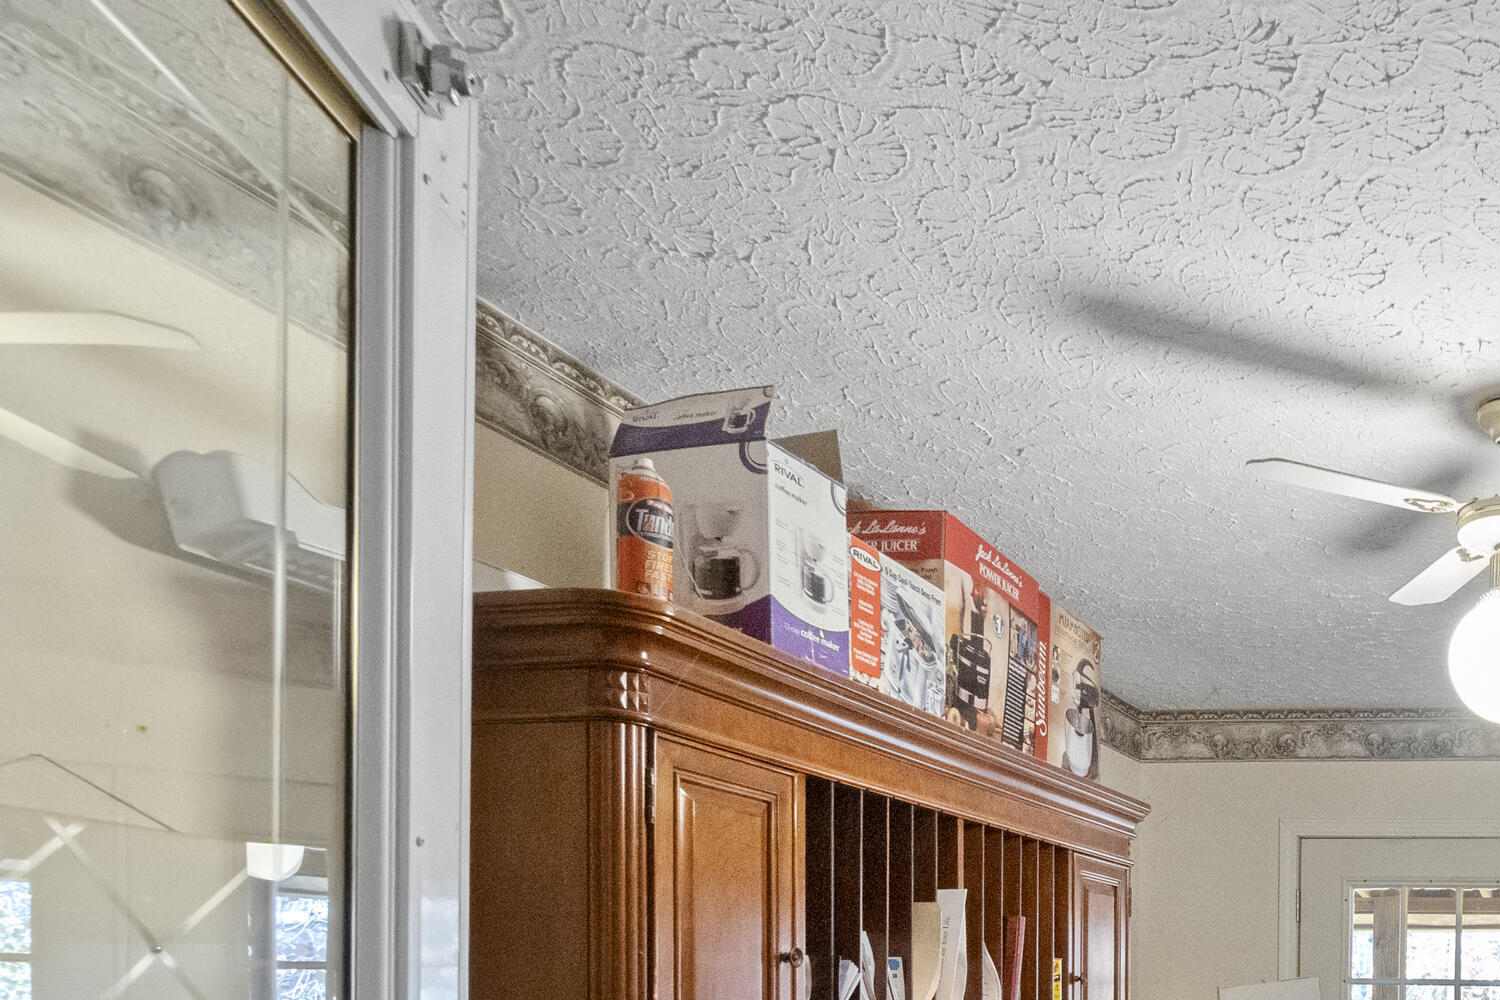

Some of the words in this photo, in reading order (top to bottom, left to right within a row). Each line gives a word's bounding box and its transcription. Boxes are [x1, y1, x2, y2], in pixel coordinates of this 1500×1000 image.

[774, 463, 805, 489] RIVAL
[881, 540, 919, 552] JUICER
[853, 549, 878, 569] RIVAL
[800, 629, 820, 643] coffee
[820, 638, 840, 652] maker
[1035, 641, 1047, 737] Sunbeam
